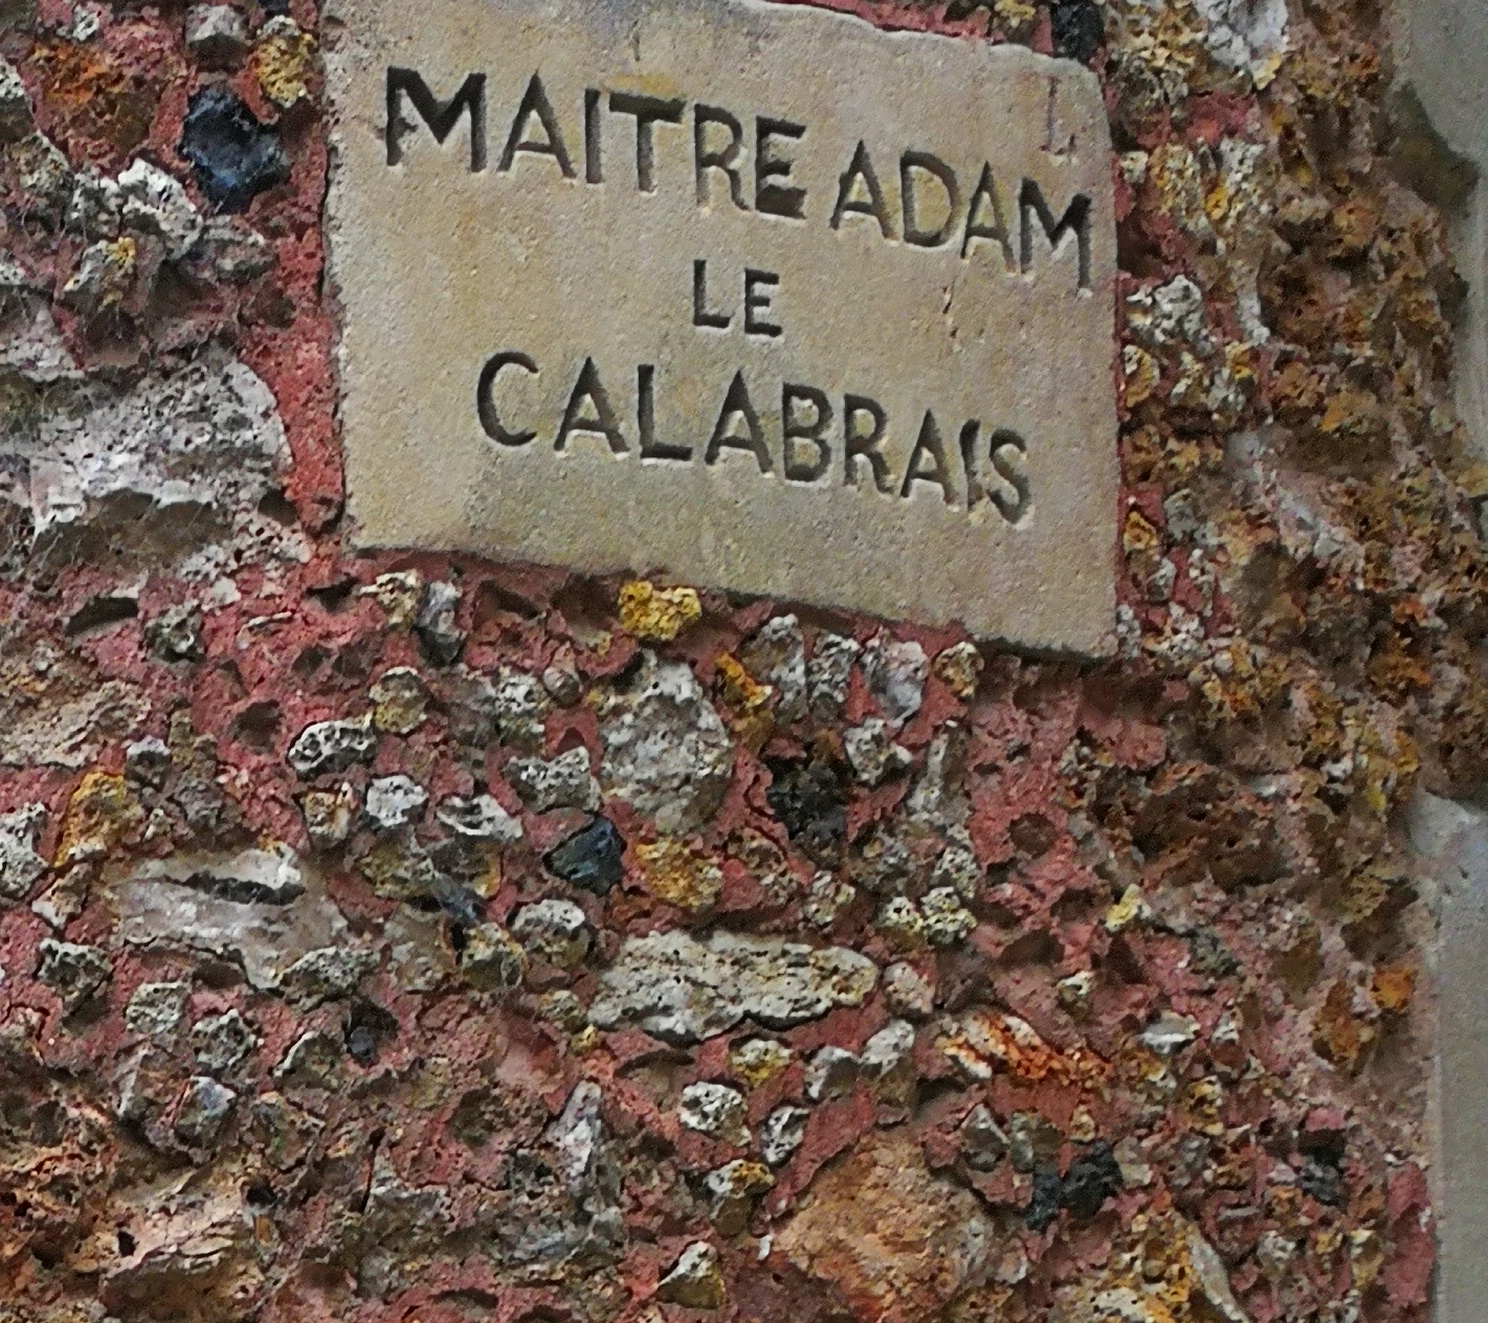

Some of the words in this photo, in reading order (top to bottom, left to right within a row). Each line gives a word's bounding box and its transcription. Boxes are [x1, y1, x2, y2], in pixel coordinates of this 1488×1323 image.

[385, 67, 809, 219] MAITRE
[830, 139, 1092, 290] ADAM
[693, 260, 782, 338] LE
[475, 352, 1030, 525] CALABRAIS
